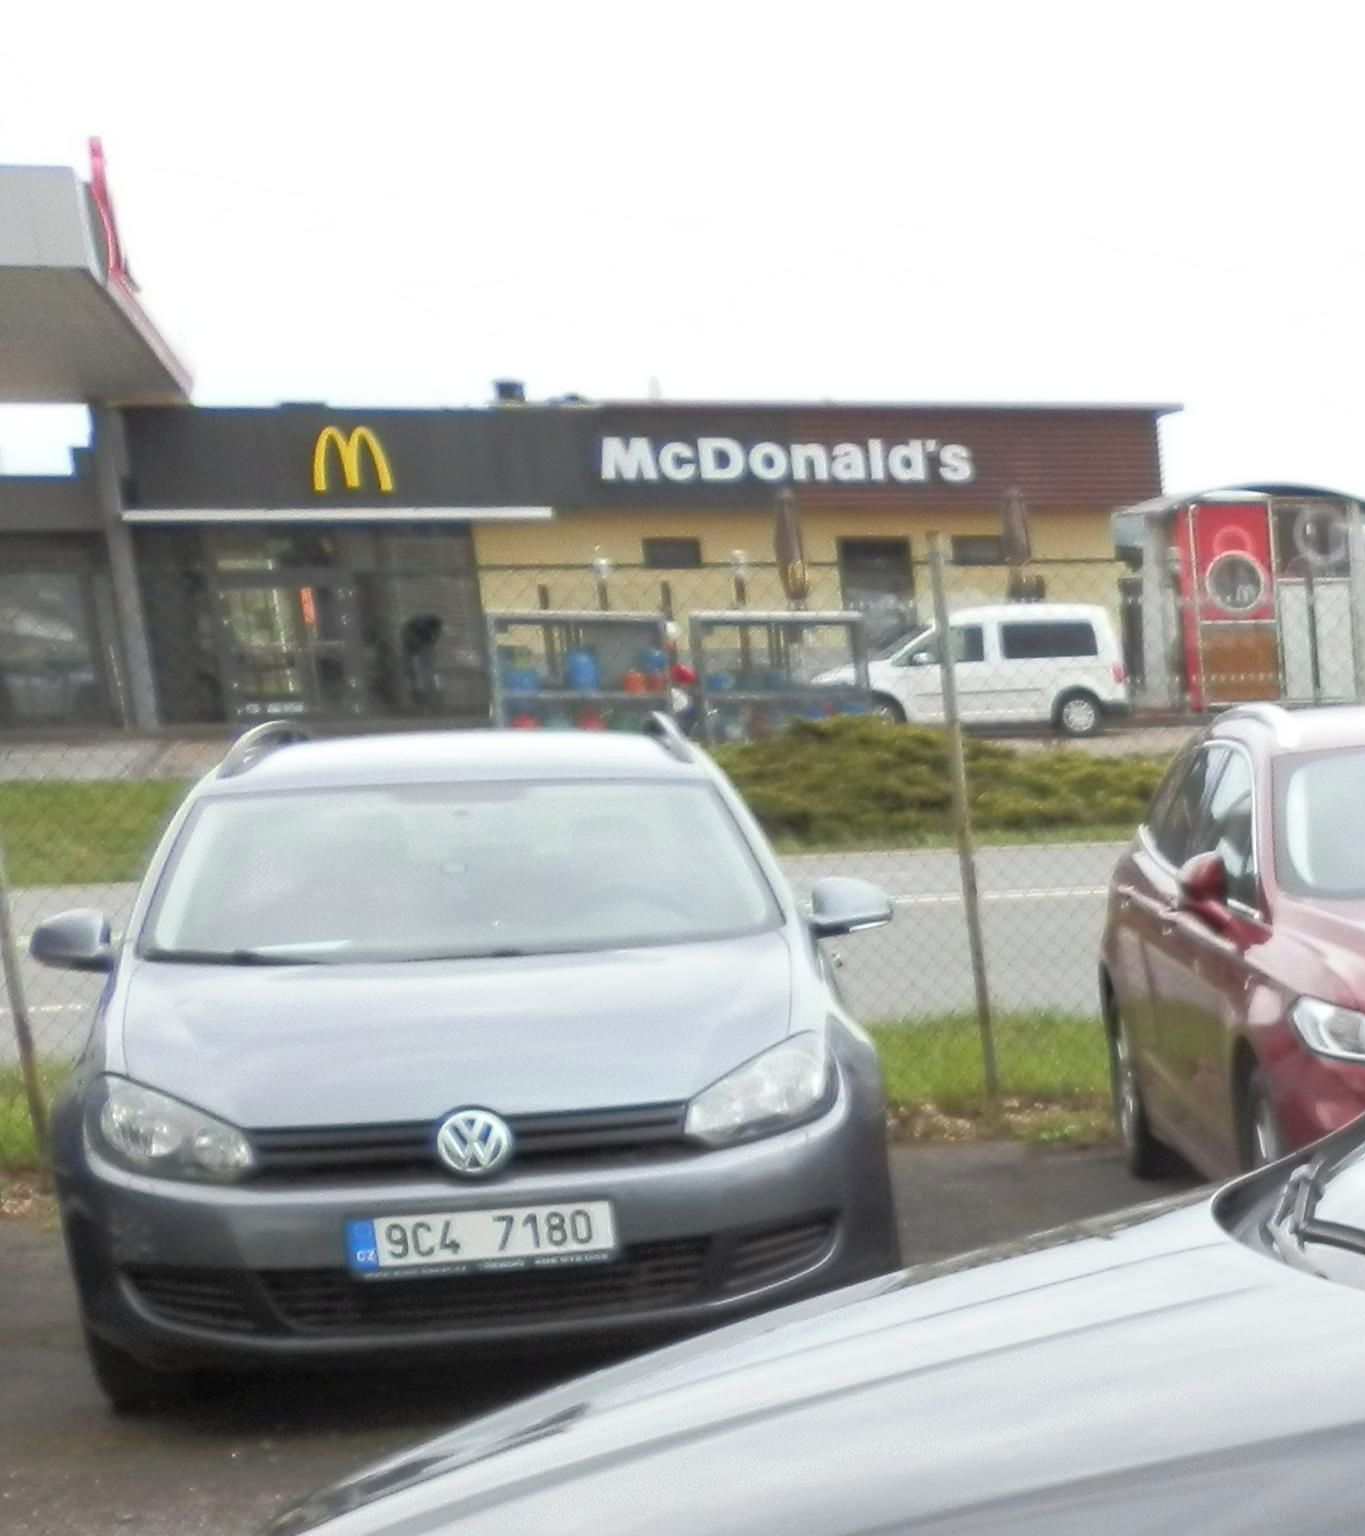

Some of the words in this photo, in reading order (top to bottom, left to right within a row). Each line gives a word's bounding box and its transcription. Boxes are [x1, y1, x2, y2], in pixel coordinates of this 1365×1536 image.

[600, 436, 972, 481] McDonald's
[384, 1219, 461, 1259] 9C4
[492, 1209, 593, 1252] 7180
